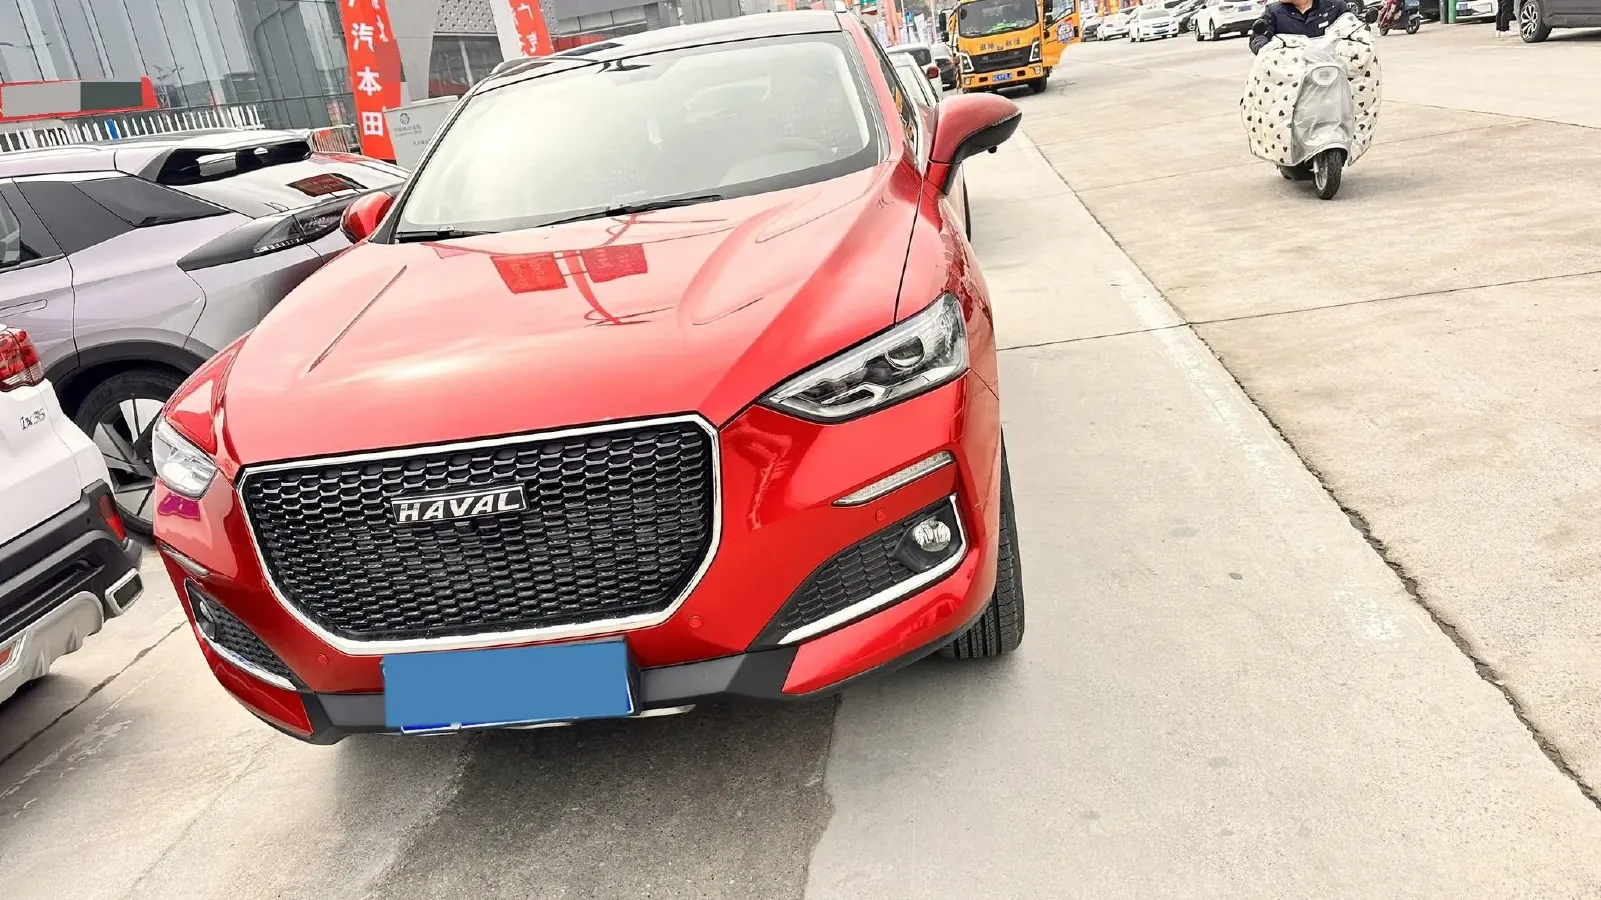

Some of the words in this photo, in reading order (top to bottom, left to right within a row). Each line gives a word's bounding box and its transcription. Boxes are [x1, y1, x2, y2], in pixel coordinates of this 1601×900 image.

[348, 0, 384, 137] 汽本田
[398, 494, 519, 523] HAVAL
